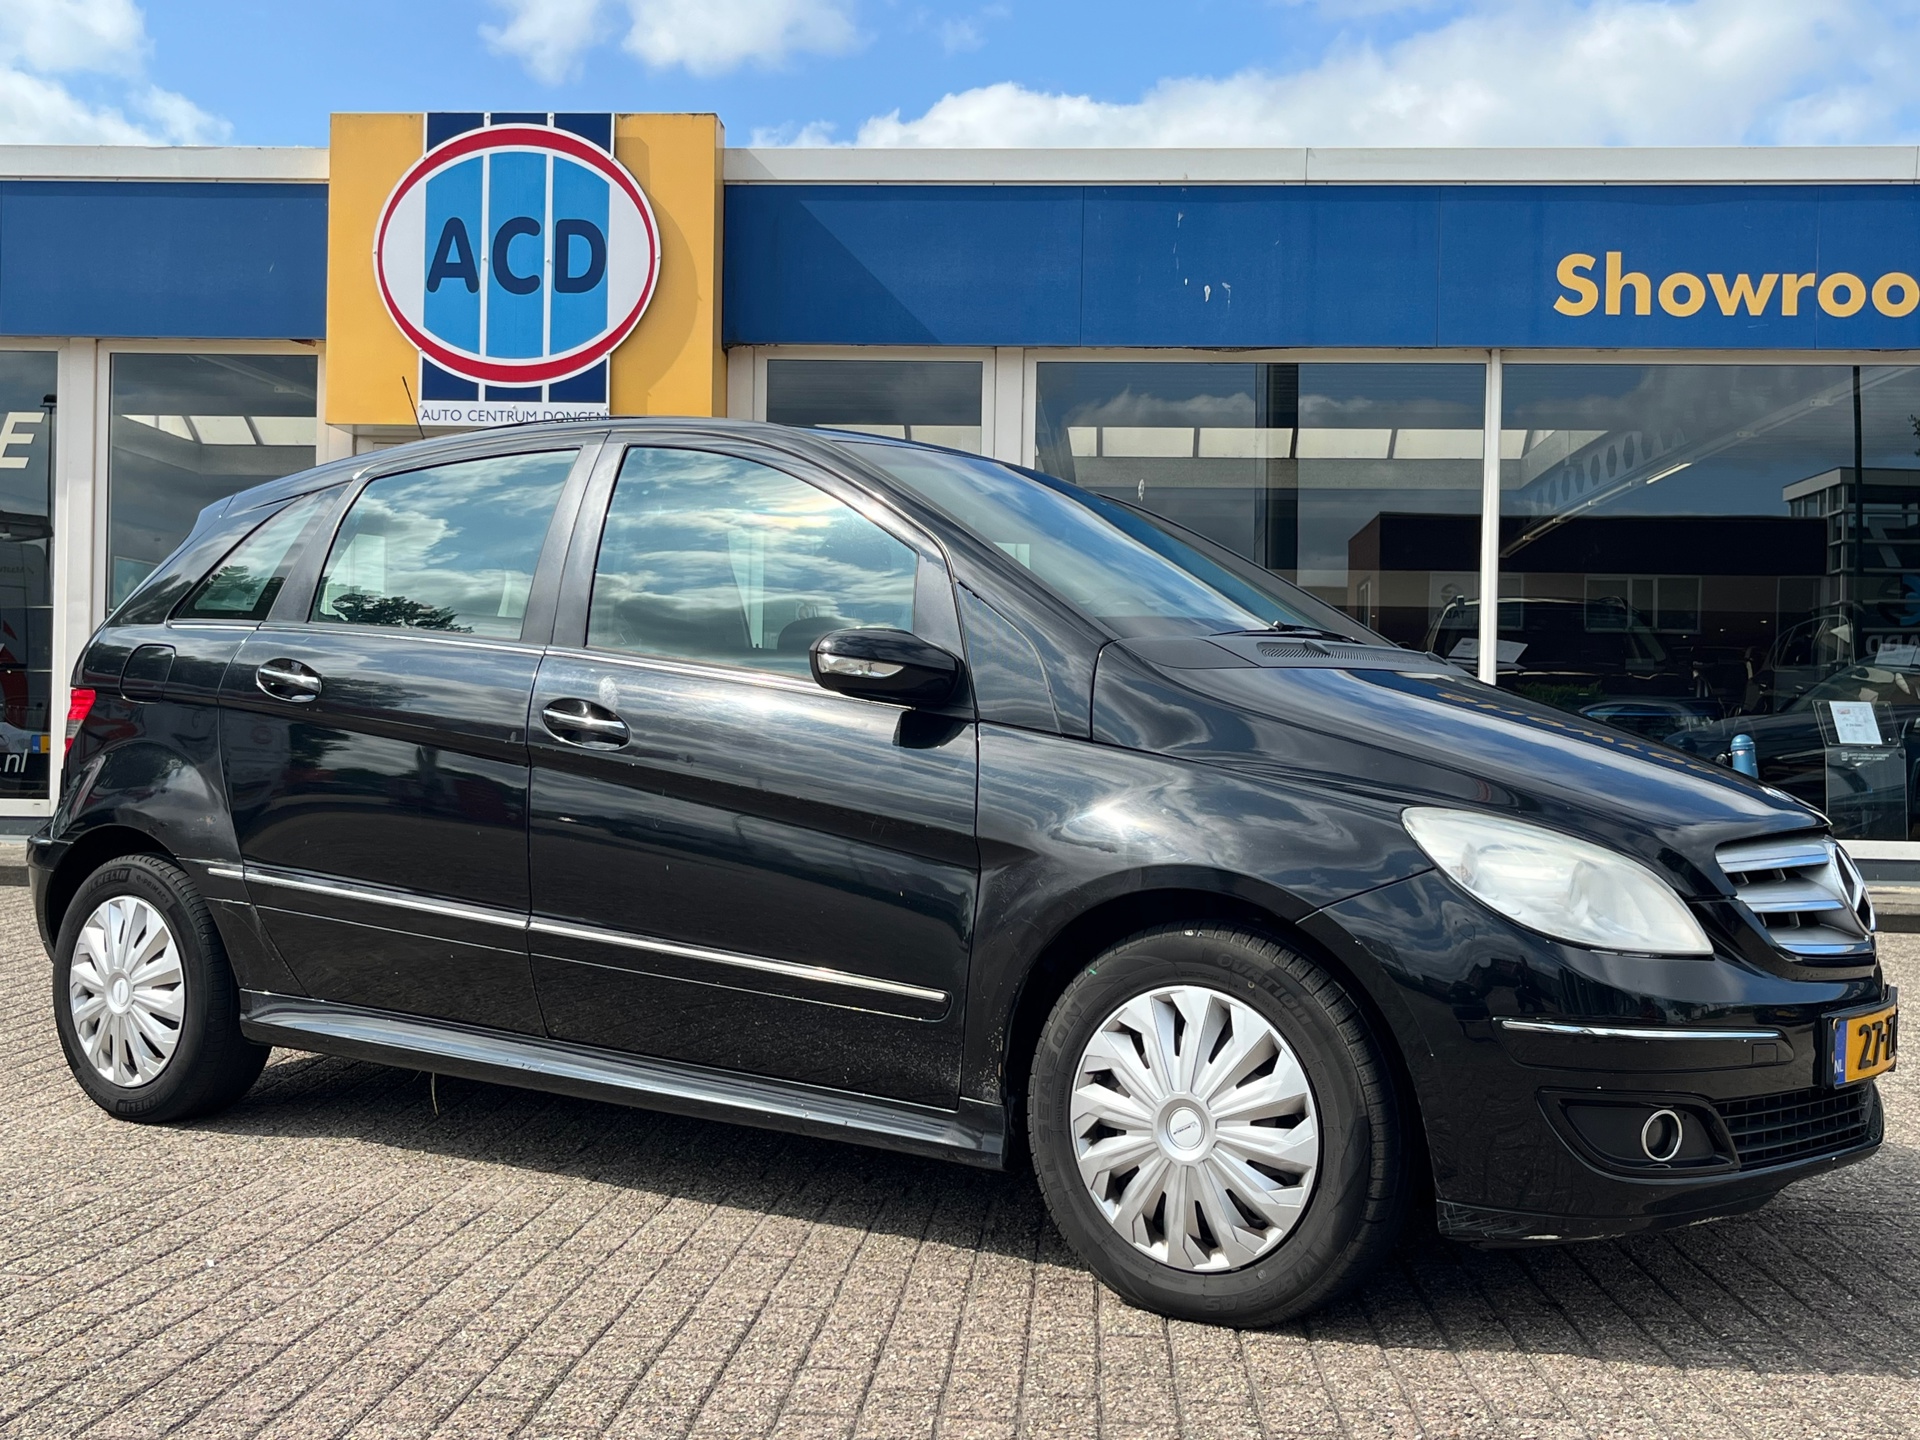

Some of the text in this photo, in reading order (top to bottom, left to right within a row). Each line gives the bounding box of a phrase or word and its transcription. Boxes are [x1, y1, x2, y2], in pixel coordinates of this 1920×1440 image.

[427, 216, 606, 294] ACD
[1553, 251, 1920, 318] Showroo
[0, 411, 45, 469] E
[421, 409, 462, 421] AUTO
[467, 410, 537, 423] CENTRUM
[1037, 1002, 1083, 1145] SEASON
[1834, 1058, 1844, 1073] NL
[117, 1085, 170, 1113] MICHELIN
